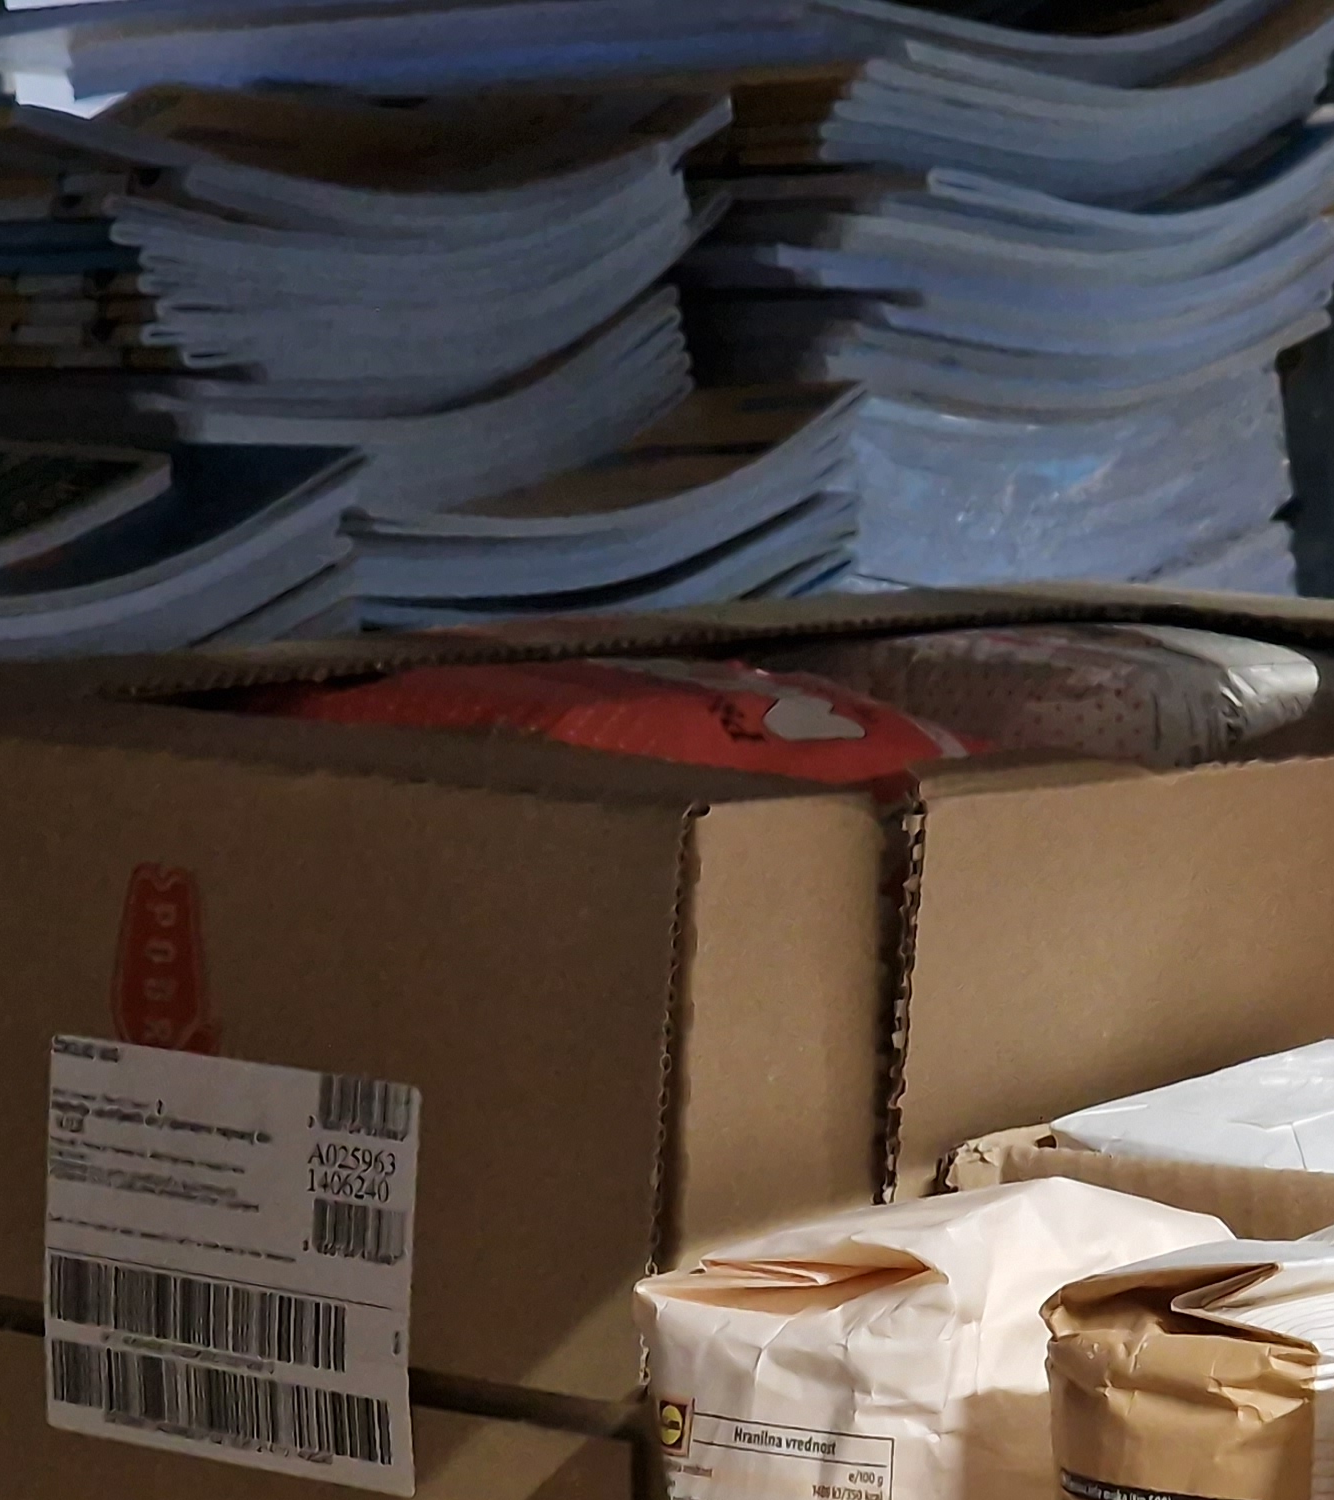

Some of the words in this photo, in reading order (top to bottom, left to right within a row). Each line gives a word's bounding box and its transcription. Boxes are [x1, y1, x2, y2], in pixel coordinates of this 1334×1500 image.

[308, 1143, 397, 1177] A025963
[307, 1168, 390, 1204] 1406240
[734, 1425, 782, 1449] Hranilna
[785, 1436, 837, 1455] vrednost
